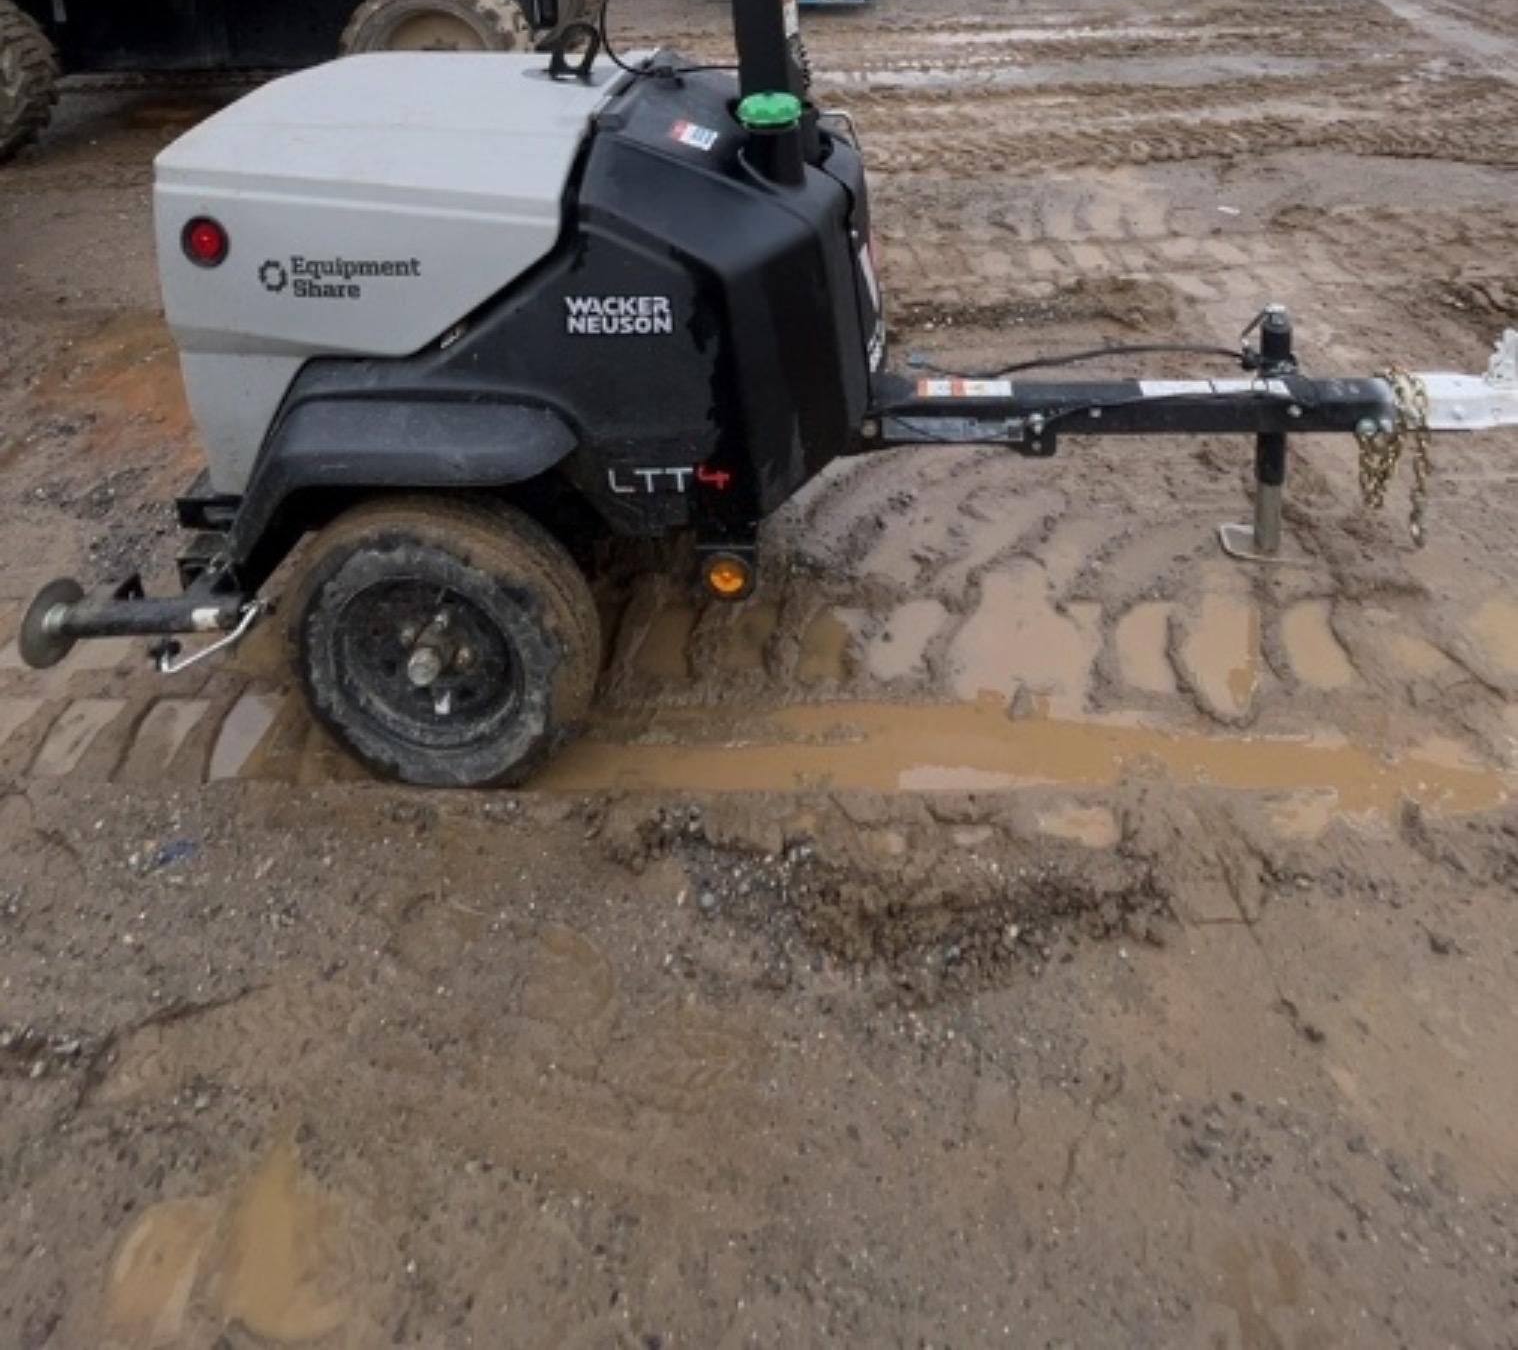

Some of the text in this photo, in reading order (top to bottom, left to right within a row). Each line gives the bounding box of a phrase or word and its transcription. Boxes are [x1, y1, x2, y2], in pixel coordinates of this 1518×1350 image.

[290, 255, 421, 279] Equipment
[292, 279, 361, 299] Share
[563, 296, 670, 316] WACKER
[567, 316, 673, 334] NEUSON
[608, 465, 730, 493] LTT4
